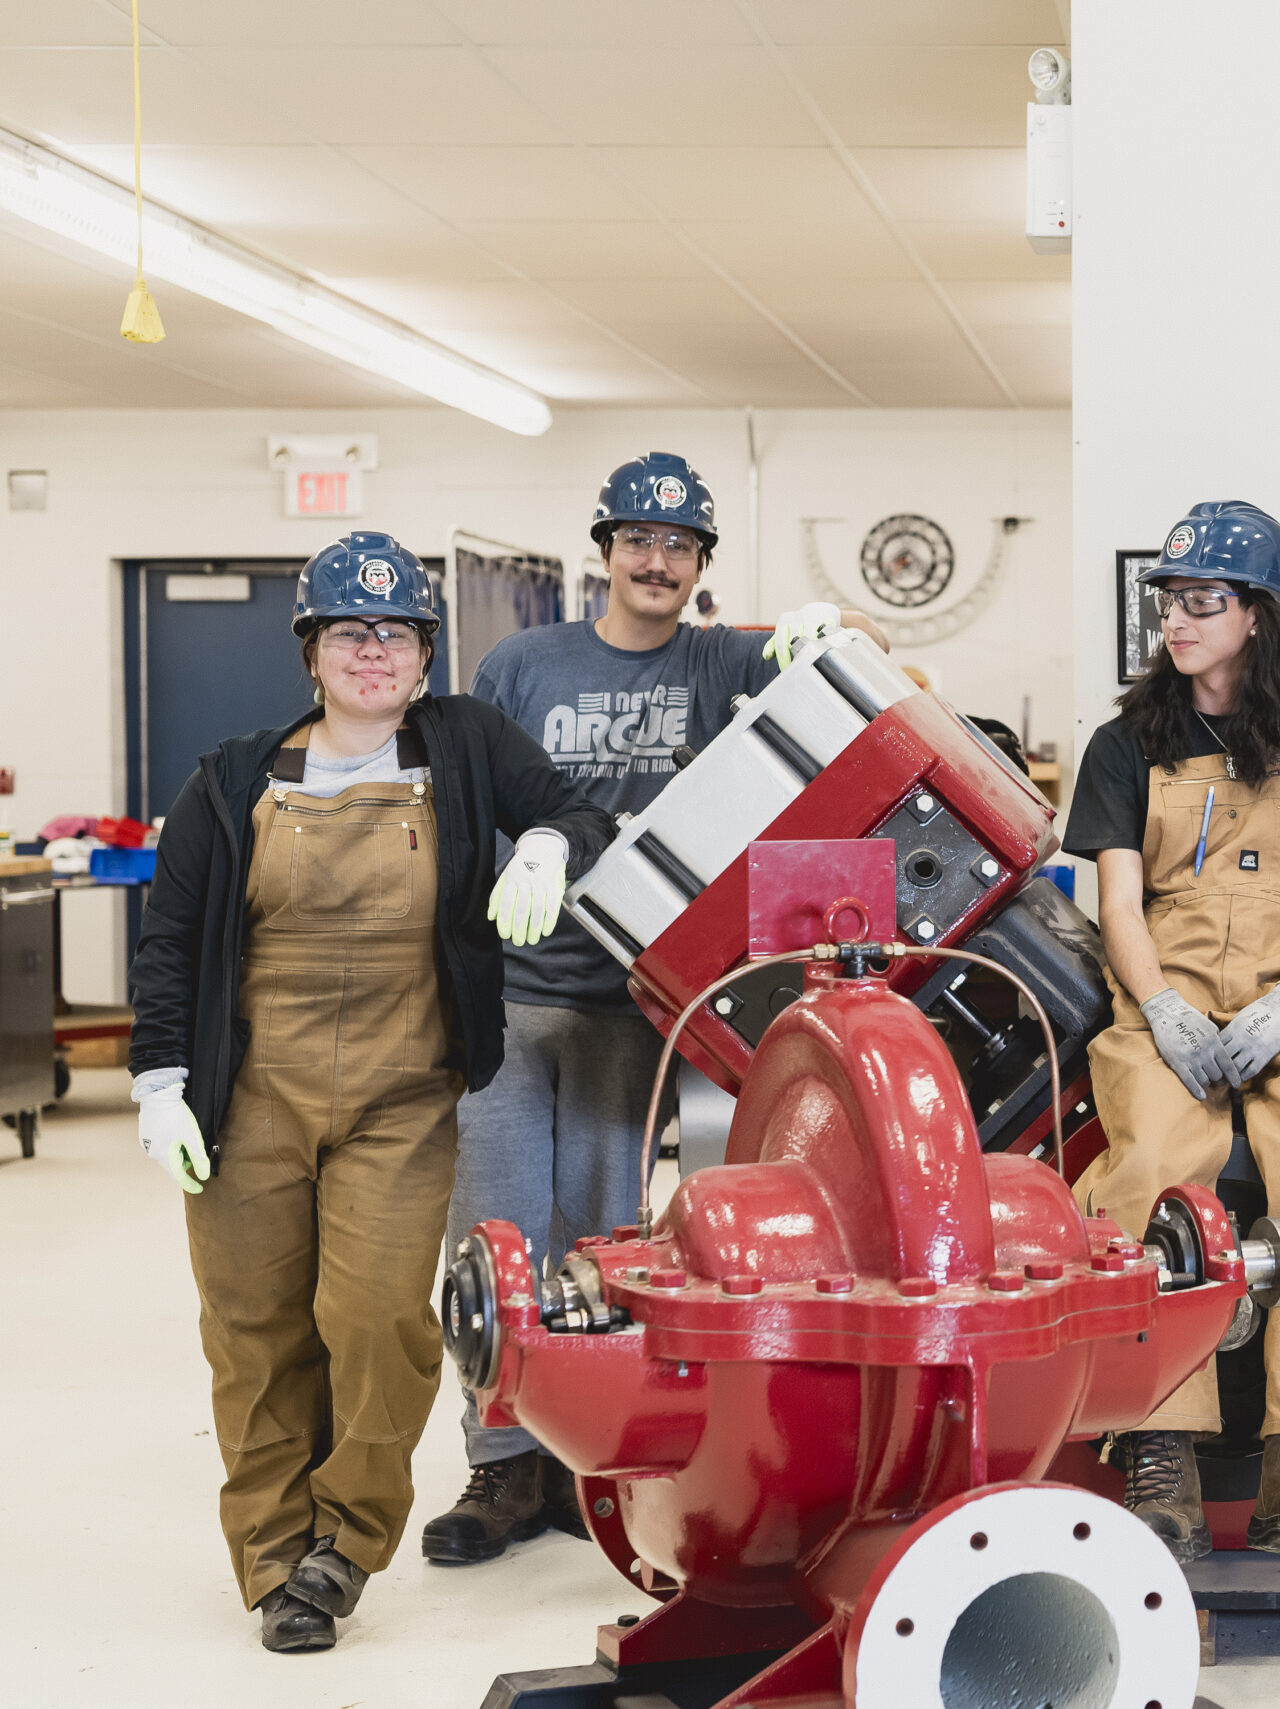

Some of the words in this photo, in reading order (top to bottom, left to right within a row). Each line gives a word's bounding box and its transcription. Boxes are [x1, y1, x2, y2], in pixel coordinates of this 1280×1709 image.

[298, 472, 348, 513] EXIT
[603, 692, 611, 713] I
[615, 684, 666, 713] NEVR
[543, 704, 688, 762] ARGUE
[651, 758, 680, 773] RIGH
[1175, 1022, 1201, 1050] HyFlex
[1245, 1012, 1272, 1036] HyFlex
